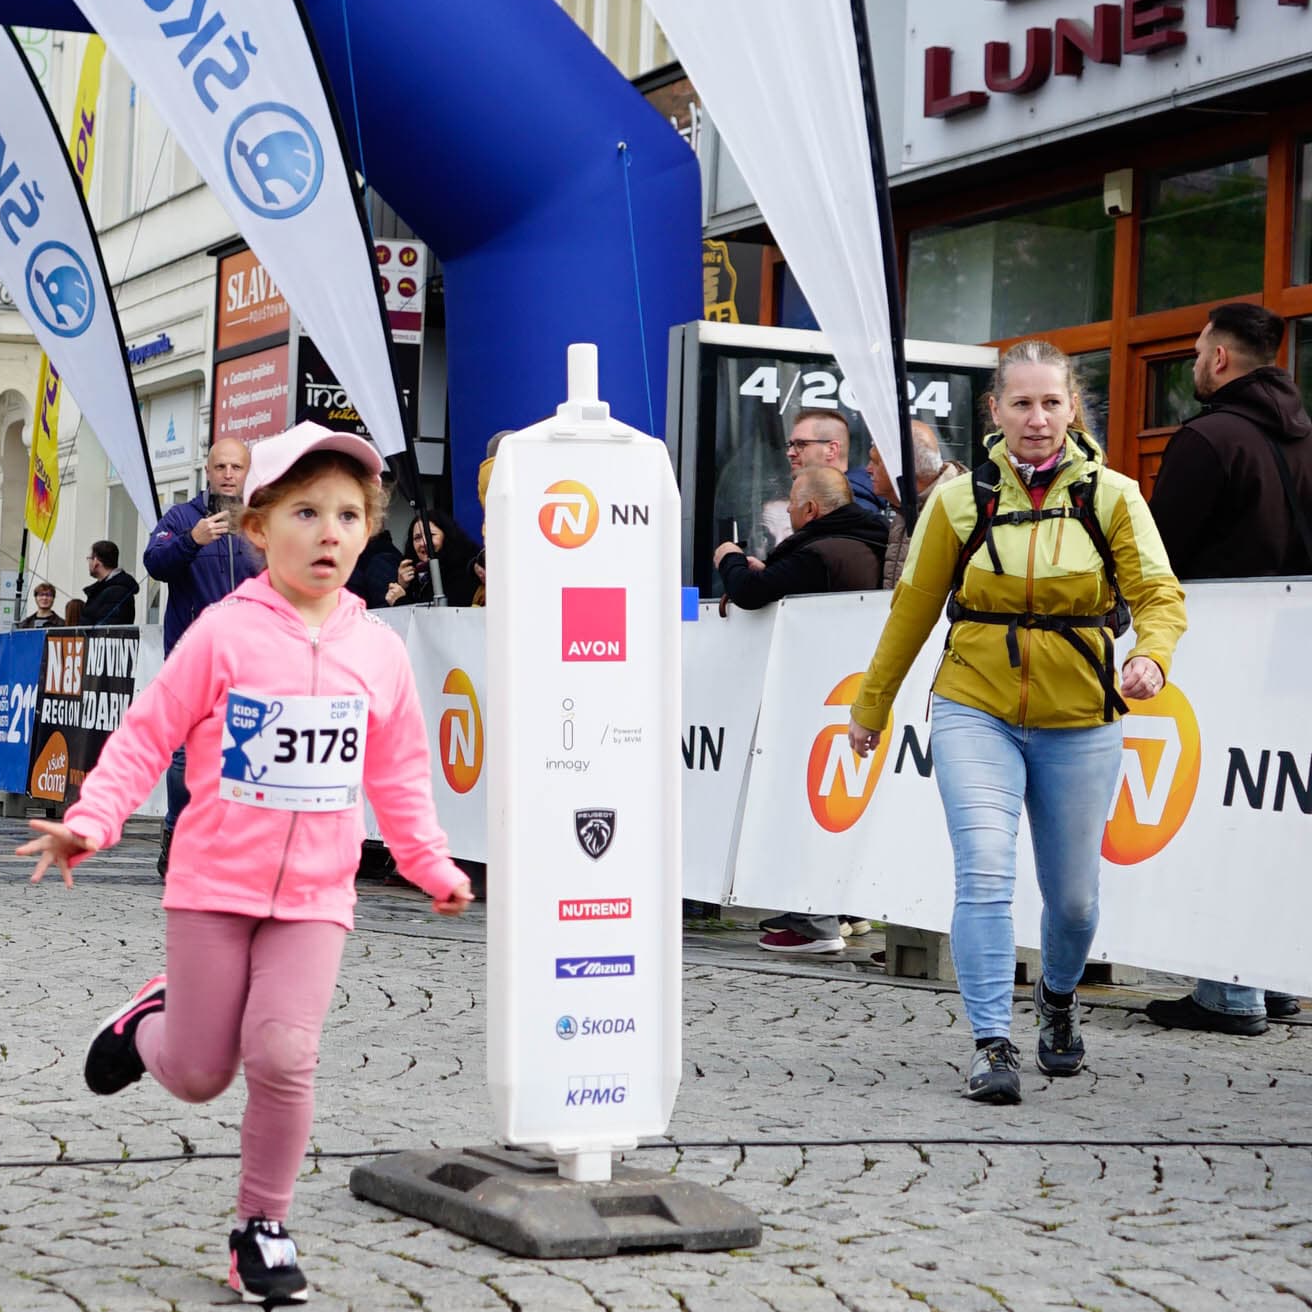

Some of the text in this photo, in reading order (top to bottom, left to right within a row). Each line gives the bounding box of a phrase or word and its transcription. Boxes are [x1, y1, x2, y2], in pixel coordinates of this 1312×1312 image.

[226, 264, 285, 312] SLAV
[611, 504, 650, 526] NN
[86, 637, 138, 679] NOVINY
[568, 641, 620, 656] AVON
[45, 640, 84, 695] Náš
[41, 698, 81, 727] REGION
[81, 690, 130, 732] ZDARM
[233, 703, 259, 718] KIDS
[331, 700, 350, 709] KIDS
[232, 717, 256, 729] CUP
[331, 711, 348, 720] CUP
[613, 727, 642, 735] Powered
[274, 726, 359, 764] 3178
[545, 757, 591, 772] innogy
[1223, 747, 1312, 815] NN
[561, 901, 629, 918] NUTREND
[581, 1017, 636, 1036] ŠKODA
[565, 1086, 626, 1107] KPMG
